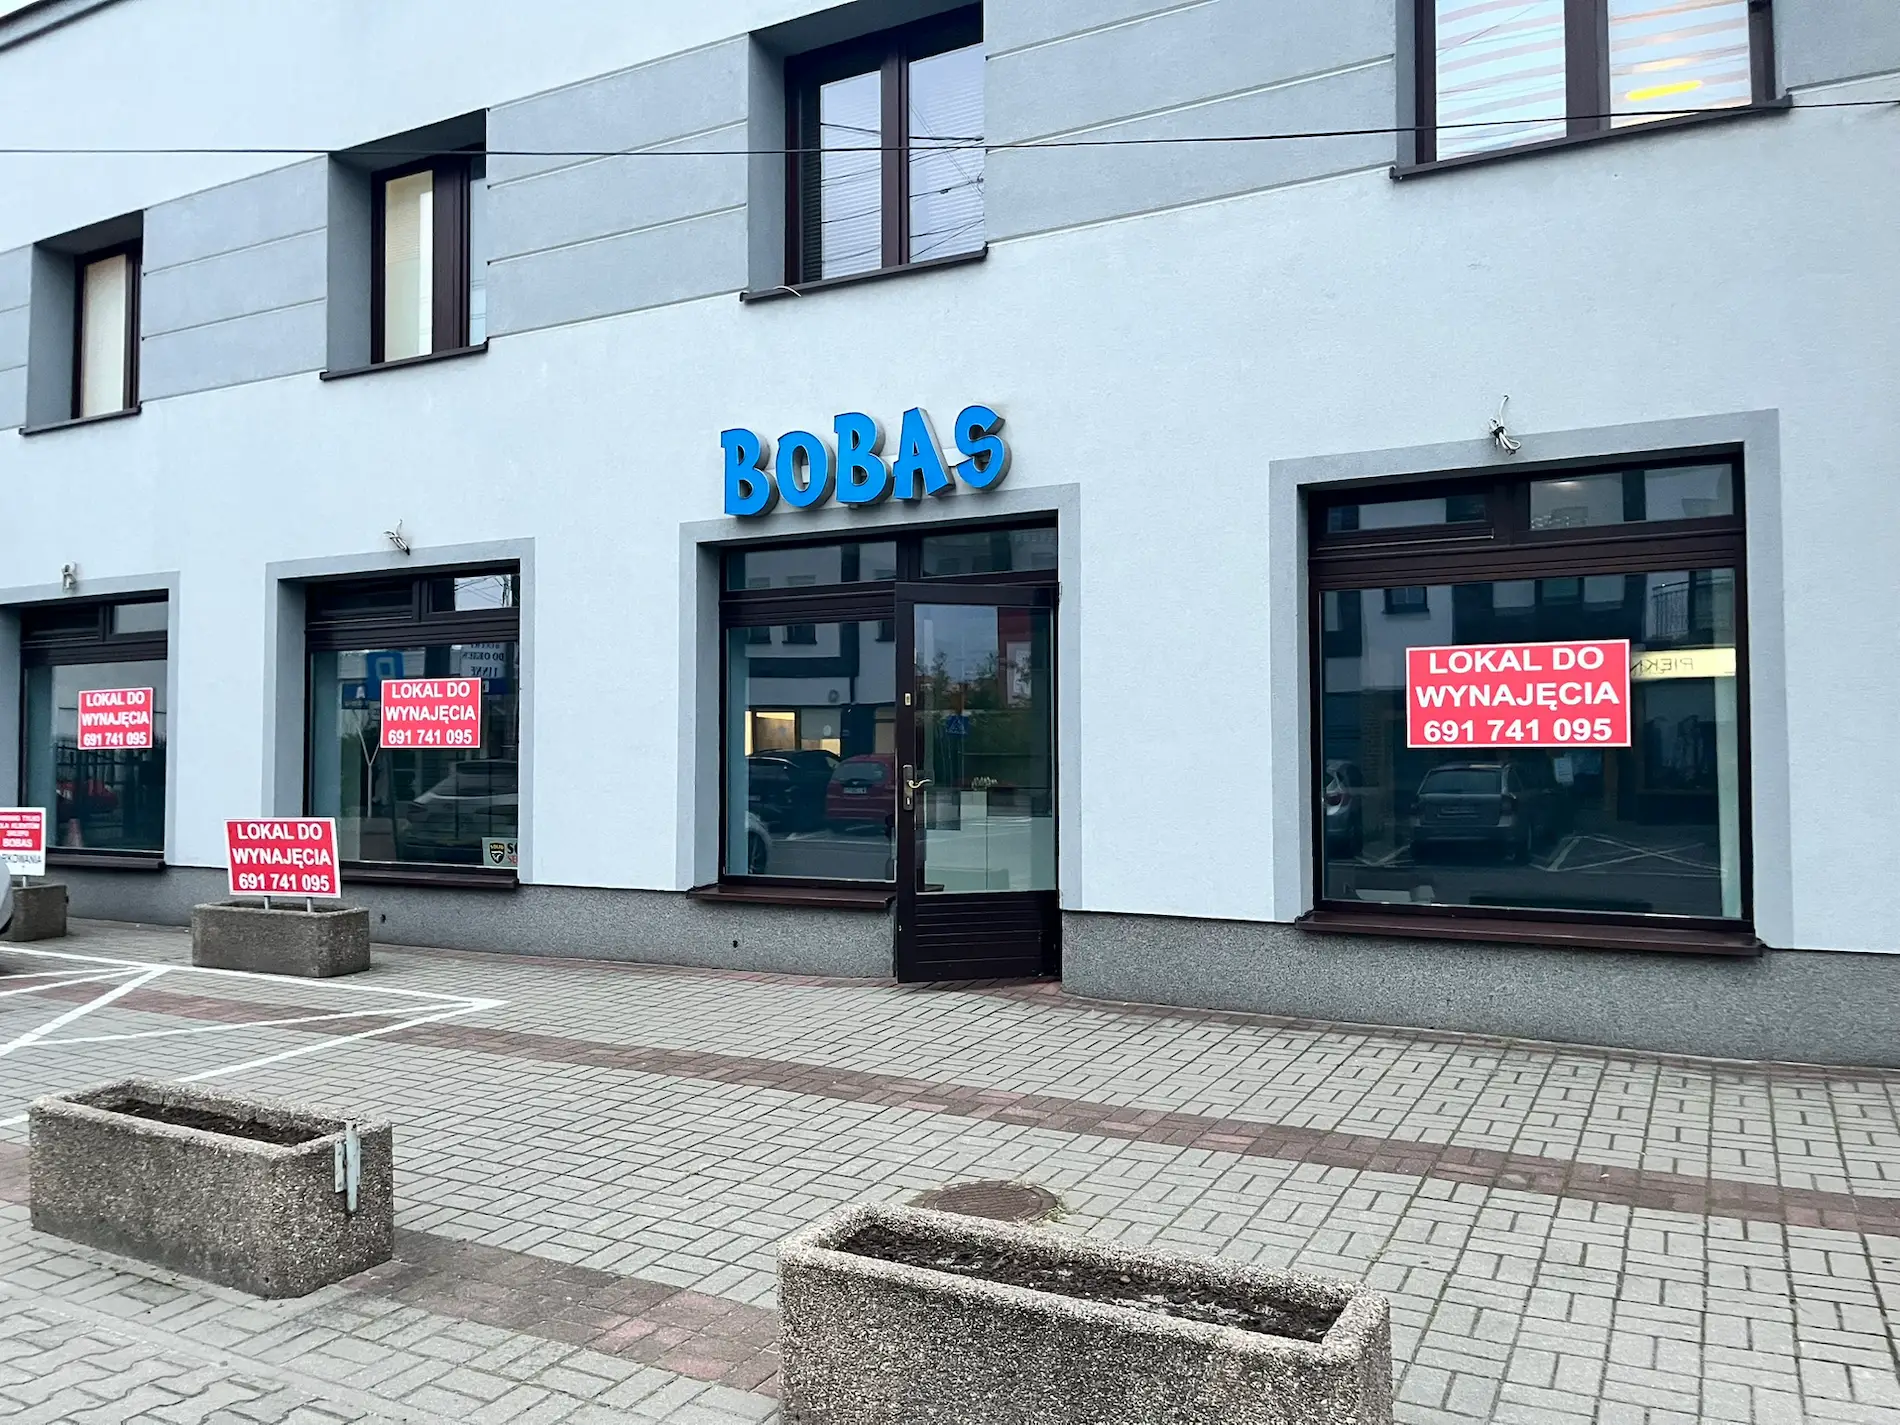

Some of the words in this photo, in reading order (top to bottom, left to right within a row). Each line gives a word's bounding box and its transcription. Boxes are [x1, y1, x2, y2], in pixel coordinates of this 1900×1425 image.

[721, 405, 1011, 516] BOBAS
[1429, 649, 1542, 674] LOKAL
[1552, 646, 1604, 670] DO
[86, 692, 125, 707] LOKAL
[126, 691, 145, 705] DO
[392, 683, 443, 699] LOKAL
[447, 681, 471, 697] DO
[1415, 681, 1620, 711] WYNAJĘCIA
[82, 711, 149, 728] WYNAJĘCIA
[385, 705, 476, 724] WYNAJĘCIA
[83, 733, 102, 747] 691
[105, 732, 123, 745] 741
[126, 731, 147, 745] 095
[388, 729, 412, 745] 691
[417, 729, 441, 744] 741
[446, 728, 473, 744] 095
[1423, 720, 1475, 742] 691
[1487, 719, 1540, 741] 741
[1553, 718, 1612, 741] 095
[237, 823, 295, 840] LOKAL
[297, 823, 323, 840] DO
[2, 838, 33, 848] BOBAS
[232, 848, 332, 869] WYNAJĘCIA
[238, 872, 265, 889] 691
[270, 873, 297, 890] 741
[301, 874, 330, 892] 095
